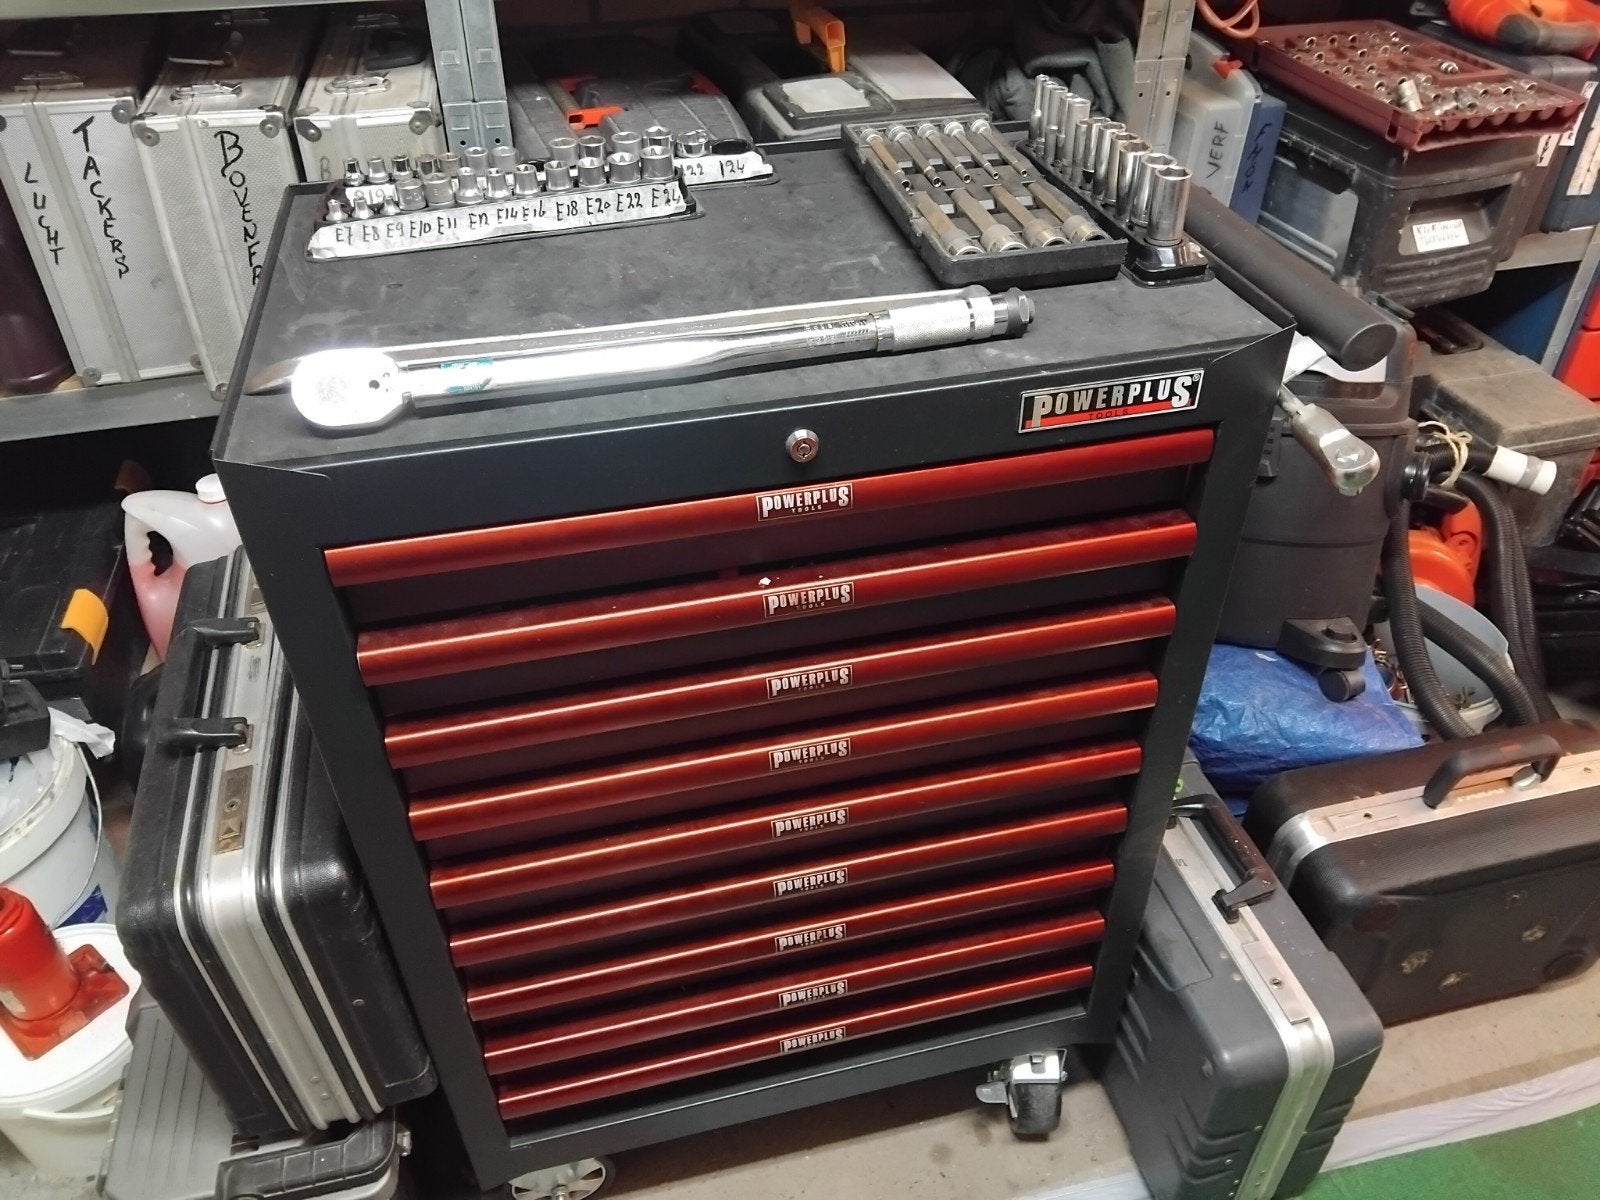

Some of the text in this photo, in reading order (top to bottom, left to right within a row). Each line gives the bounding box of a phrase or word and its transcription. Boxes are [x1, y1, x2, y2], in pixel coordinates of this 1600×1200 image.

[1206, 120, 1230, 179] VERF
[72, 115, 130, 280] TACKERS
[24, 162, 65, 265] LUCHT
[335, 227, 353, 245] E7
[363, 224, 380, 242] E8
[386, 221, 405, 238] E9
[410, 219, 432, 238] E10
[437, 216, 458, 235] E11
[497, 208, 518, 224] E14
[522, 199, 546, 222] E16
[556, 200, 578, 221] E18
[586, 198, 611, 215] E20
[616, 192, 643, 212] E22
[1031, 375, 1193, 428] POWERPLUS
[1088, 408, 1129, 421] TOOLS
[762, 486, 849, 518] POWERPLUS
[791, 504, 822, 514] TOOLS
[767, 585, 850, 615] POWERPLUS
[771, 667, 849, 696] POWERPLUS
[773, 740, 848, 769] POWERPLUS
[775, 809, 846, 838] POWERPLUS
[777, 870, 845, 896] POWERPLUS
[779, 926, 843, 952] POWERPLUS
[783, 982, 845, 1007] POWERPLUS
[783, 1028, 843, 1052] POWERPLUS
